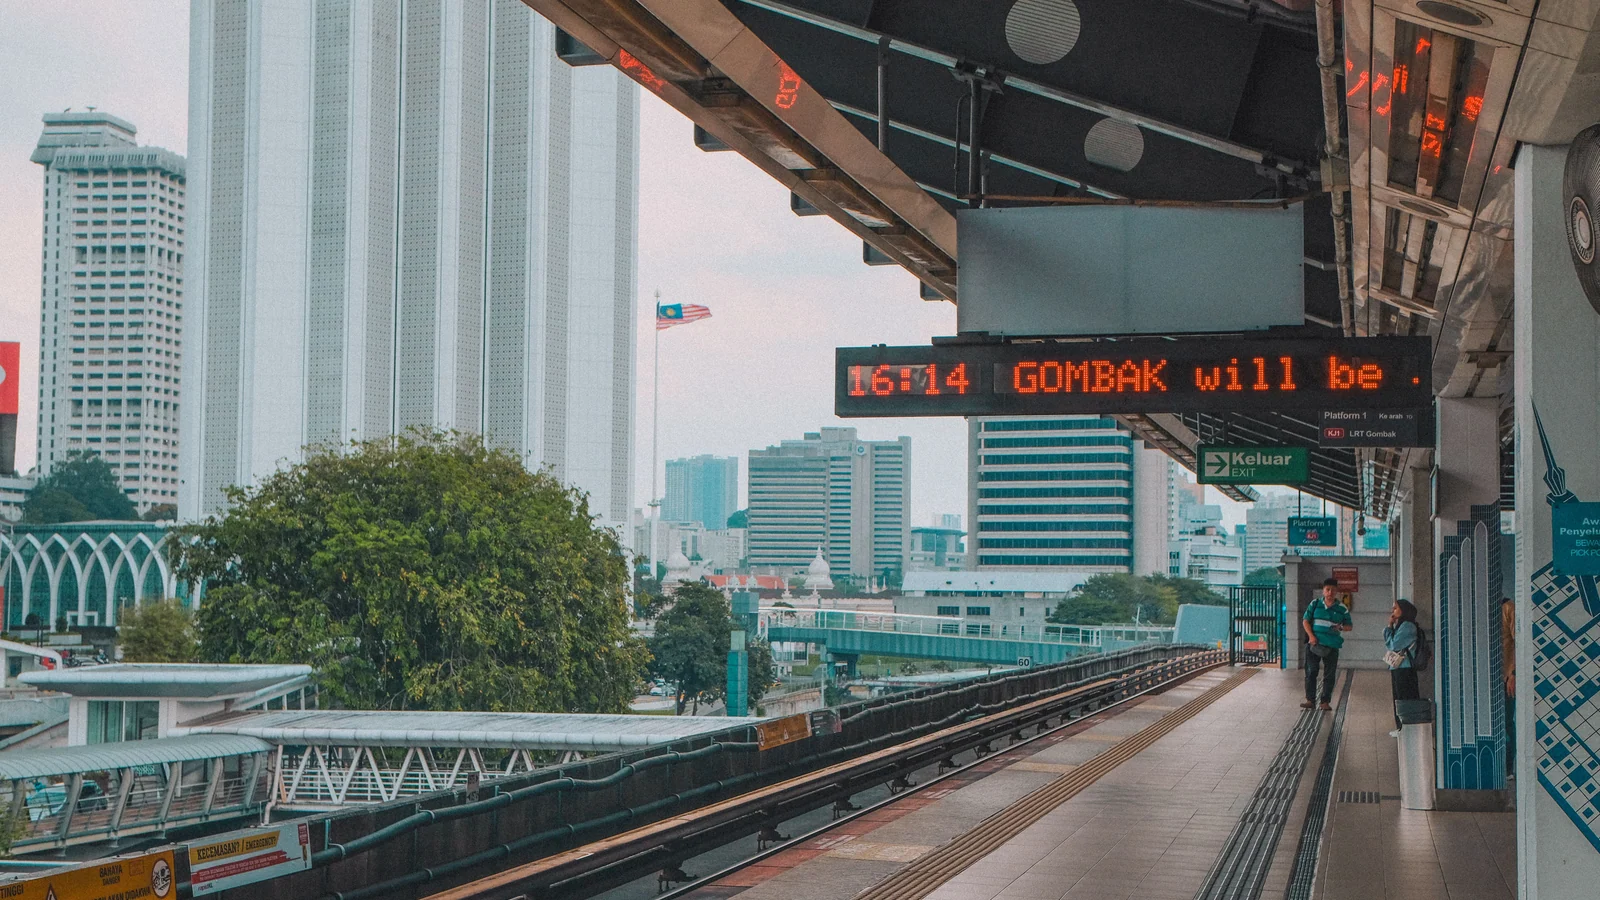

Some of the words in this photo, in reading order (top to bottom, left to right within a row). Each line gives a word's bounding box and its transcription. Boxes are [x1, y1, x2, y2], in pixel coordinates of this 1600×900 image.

[849, 363, 969, 396] 16:14
[1013, 360, 1167, 394] GOMBAK
[1195, 356, 1297, 391] will
[1328, 356, 1384, 390] be
[1324, 411, 1360, 420] Platform
[1362, 411, 1367, 420] 1
[1389, 412, 1403, 420] arah
[1349, 430, 1364, 438] LRT
[1366, 430, 1397, 438] Gombak
[1232, 452, 1292, 466] Keluar
[1232, 468, 1256, 477] EXIT
[1582, 517, 1600, 526] Aw
[1575, 539, 1600, 547] BEWA
[1570, 548, 1589, 556] PICK
[1018, 658, 1030, 667] 60
[197, 841, 240, 861] KECEMASAN?
[245, 836, 277, 851] EMERGENCY?
[99, 864, 123, 878] BAHAYA
[102, 875, 121, 886] DANGER
[0, 884, 24, 899] TINGGI
[125, 886, 152, 900] DIDAKWA
